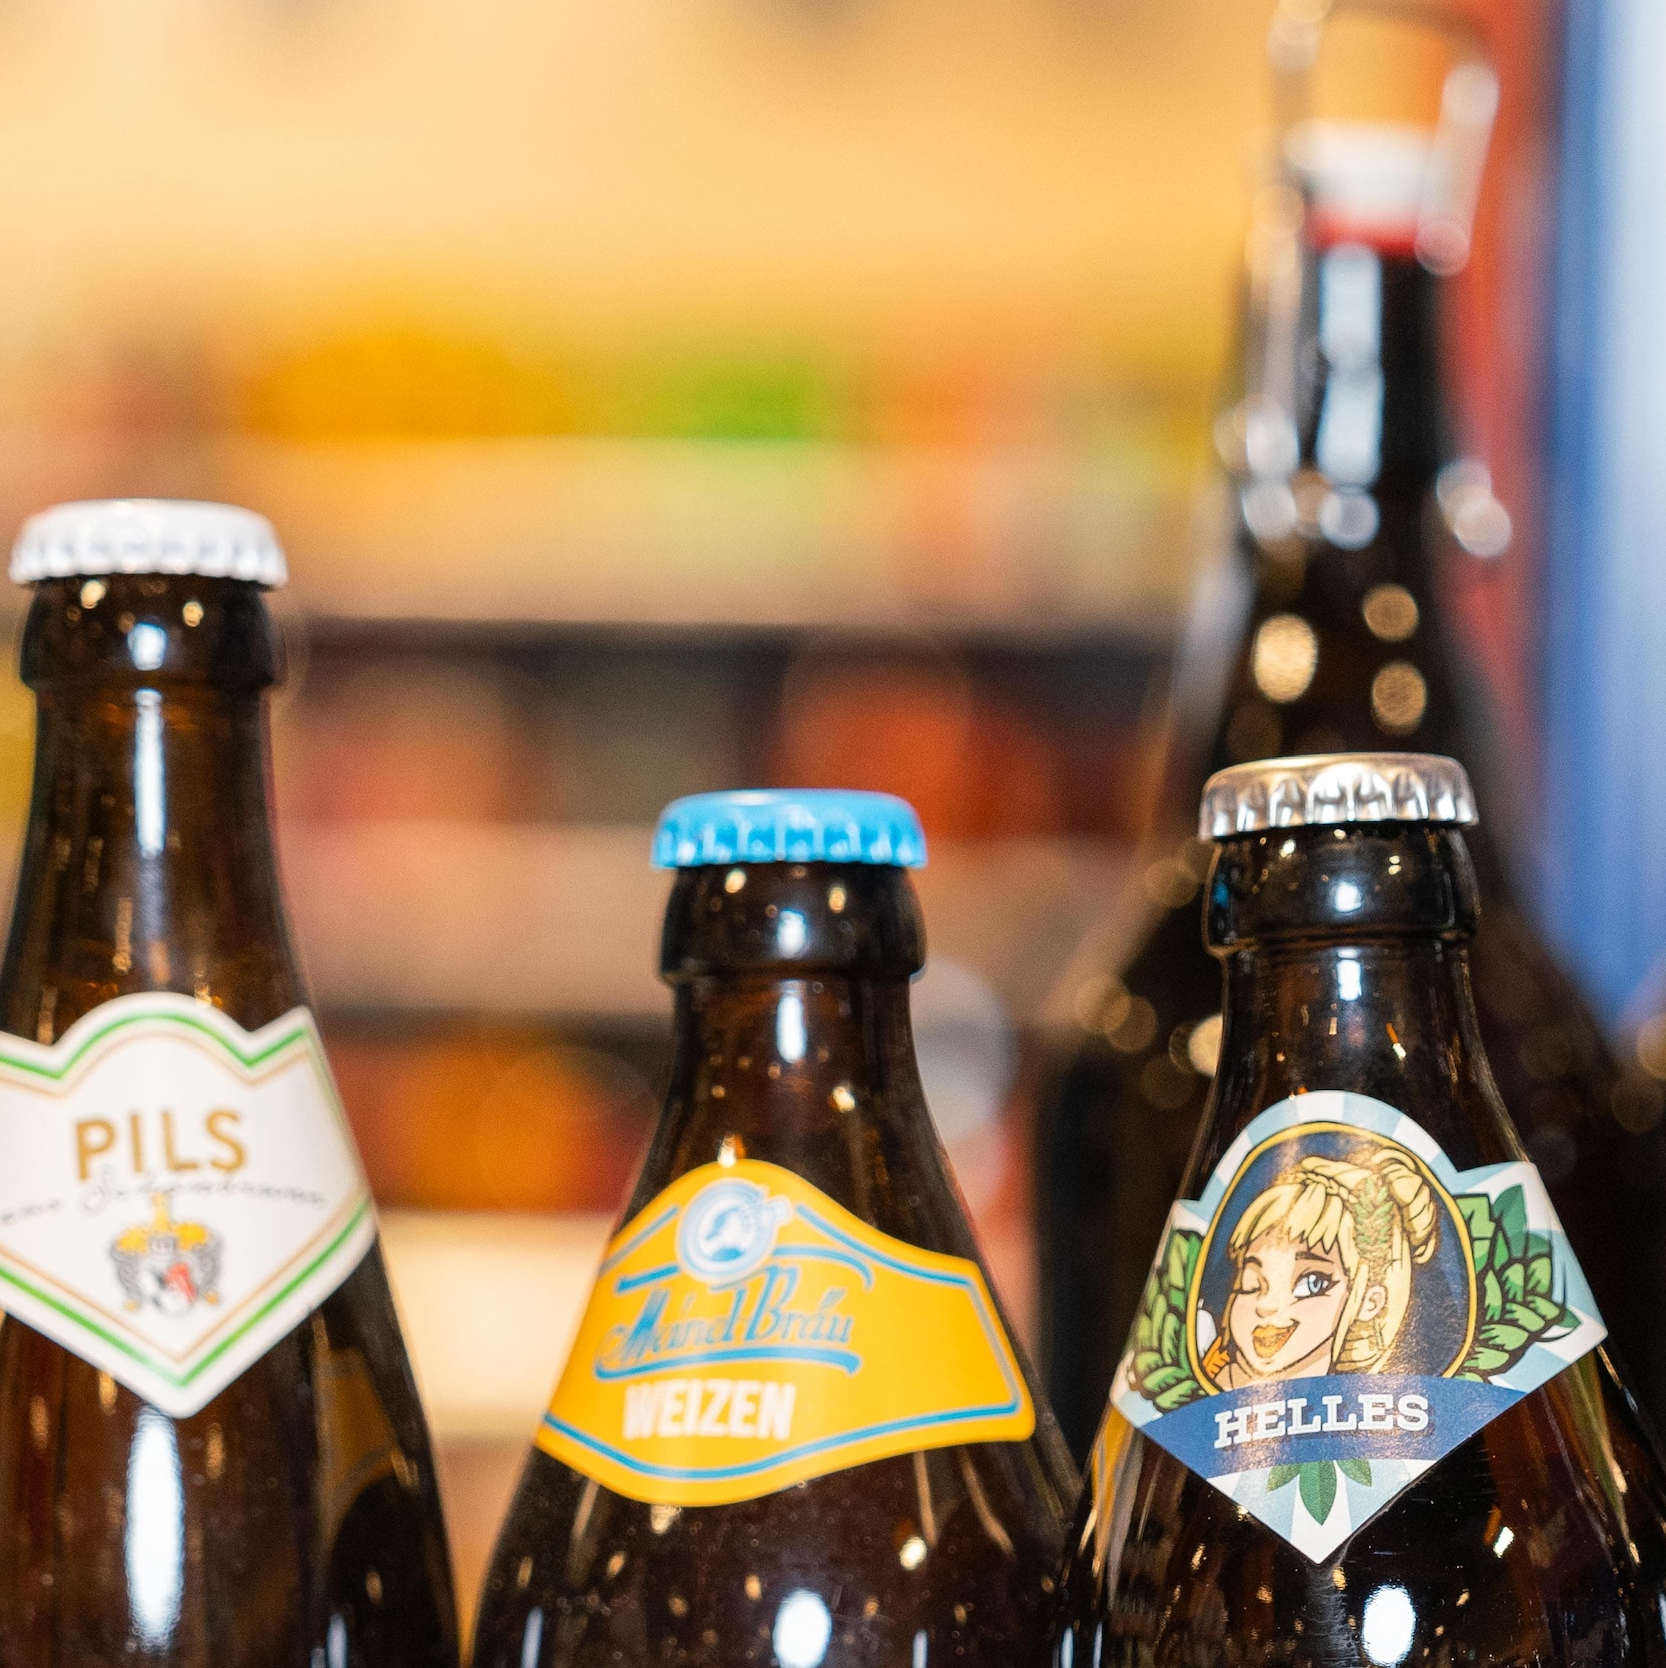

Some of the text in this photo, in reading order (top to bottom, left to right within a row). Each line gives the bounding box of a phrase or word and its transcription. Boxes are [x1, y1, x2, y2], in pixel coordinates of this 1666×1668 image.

[74, 1107, 250, 1181] PILS
[622, 1377, 797, 1441] WEIZEN
[1213, 1393, 1430, 1450] HELLES
